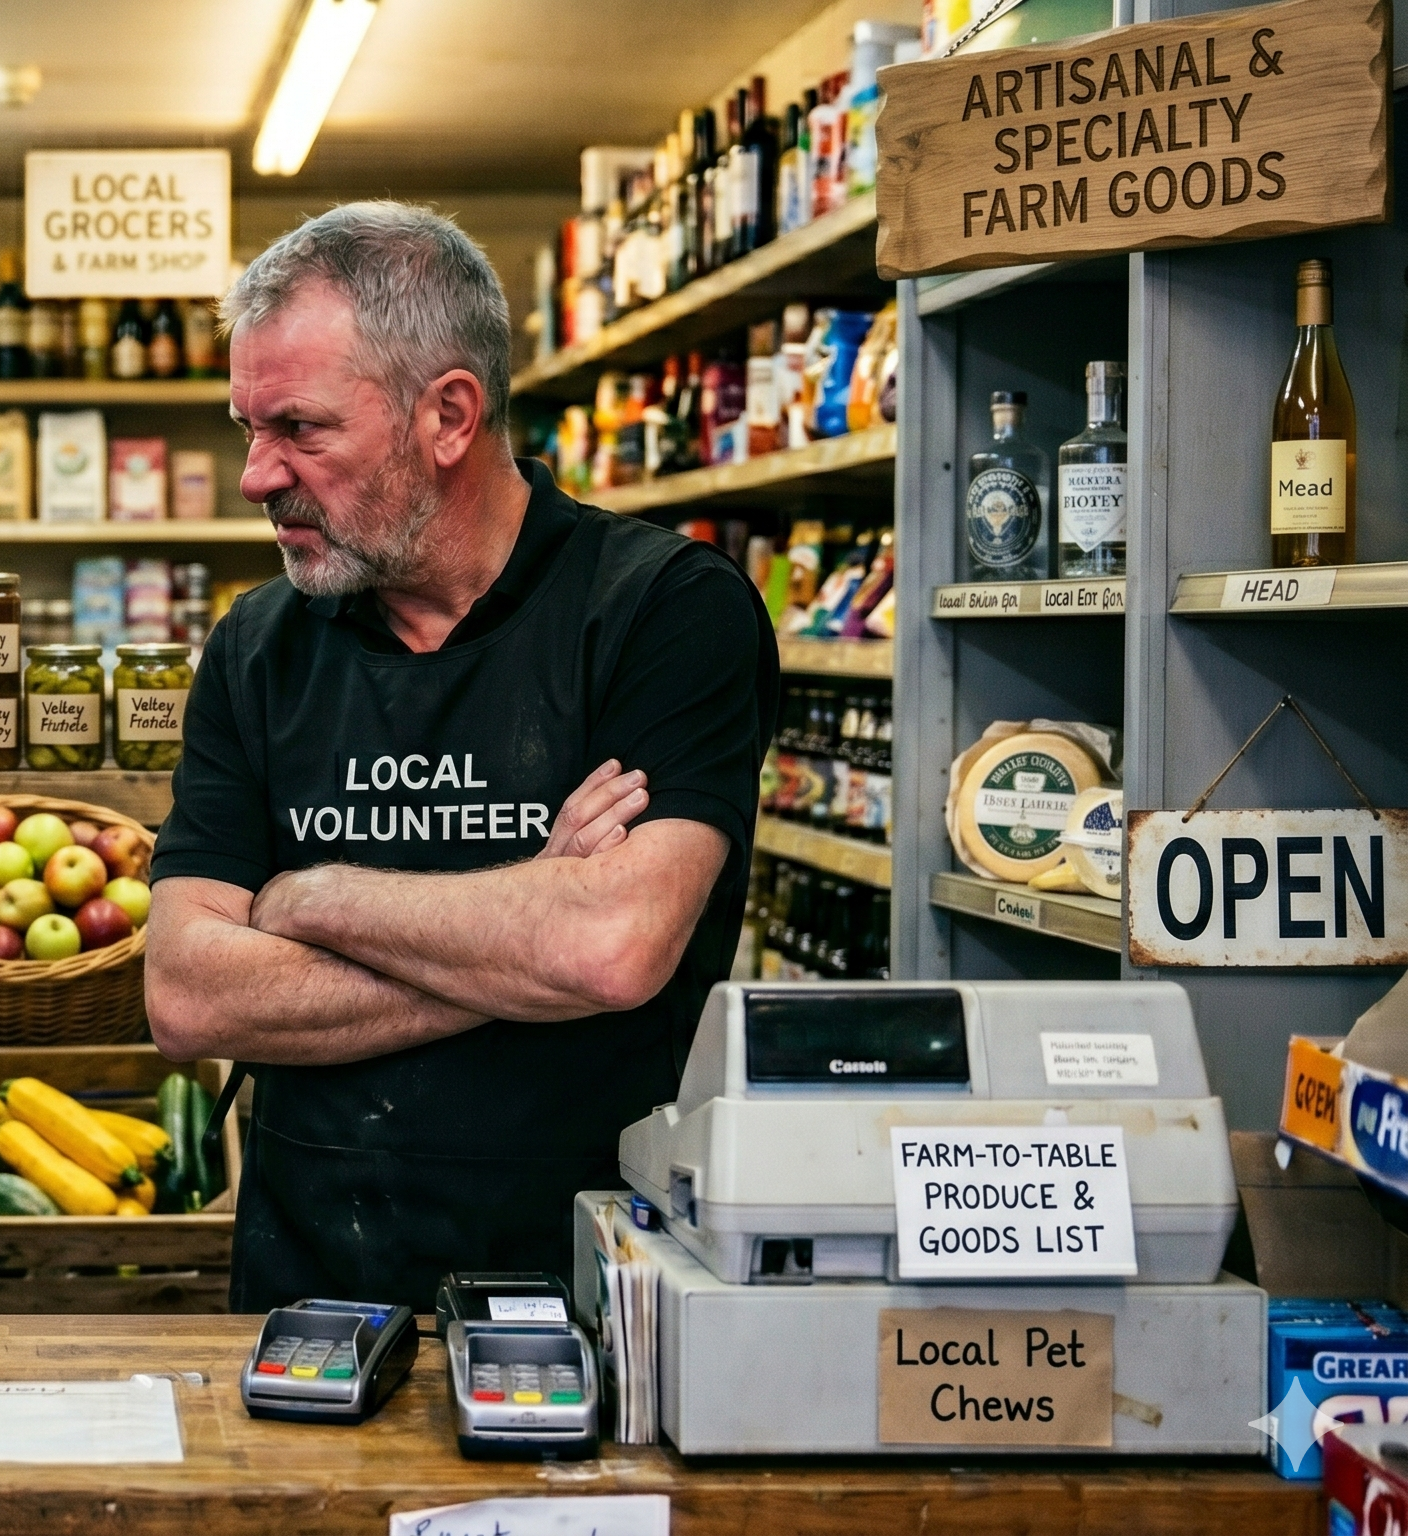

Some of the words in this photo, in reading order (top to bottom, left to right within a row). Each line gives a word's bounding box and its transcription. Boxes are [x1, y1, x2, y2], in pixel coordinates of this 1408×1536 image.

[962, 37, 1232, 121] ARTISANAL
[1249, 28, 1285, 78] &
[994, 93, 1253, 174] SPECIALTY
[72, 173, 185, 204] LOCAL
[963, 177, 1088, 238] FARM
[1108, 151, 1287, 218] GOODS
[44, 210, 213, 241] GROCERS
[53, 253, 67, 272] &
[77, 253, 137, 272] FARM
[147, 252, 206, 272] SHOP
[1278, 477, 1333, 497] Mead
[1240, 578, 1299, 602] HEAD
[345, 753, 488, 791] LOCAL
[289, 802, 550, 841] VOLUNTEER
[1156, 836, 1386, 941] OPEN
[901, 1142, 1117, 1168] FARM-TO-TABLE
[924, 1182, 1058, 1210] PRODUCE
[1073, 1180, 1095, 1210] &
[919, 1225, 1020, 1256] GOODS
[1036, 1225, 1104, 1253] LIST
[897, 1328, 999, 1366] Local
[1026, 1327, 1086, 1368] Pet
[930, 1383, 1055, 1422] Chews
